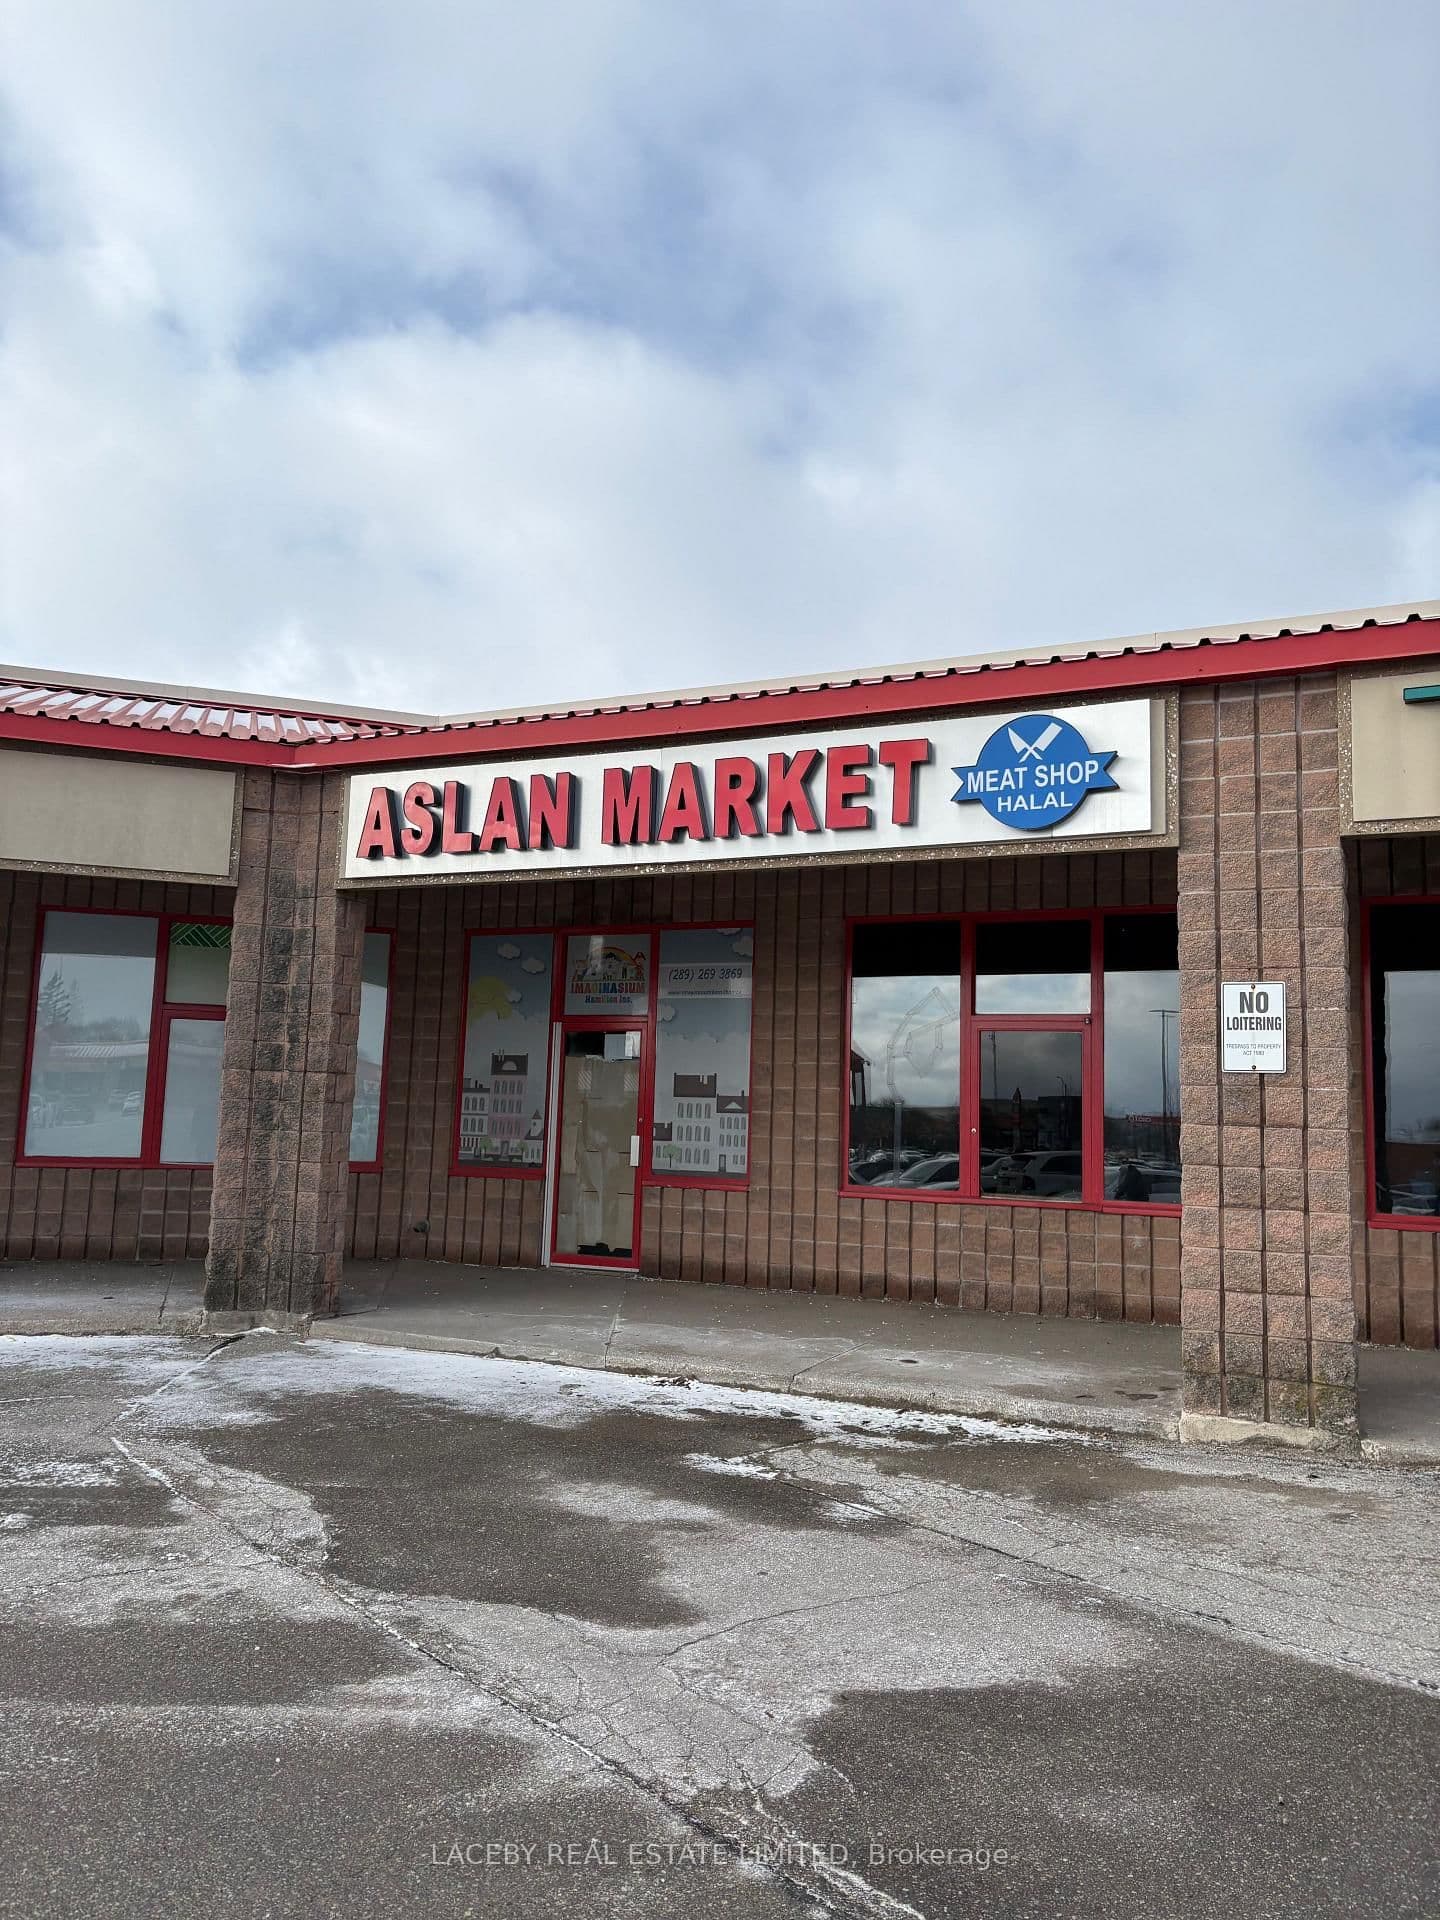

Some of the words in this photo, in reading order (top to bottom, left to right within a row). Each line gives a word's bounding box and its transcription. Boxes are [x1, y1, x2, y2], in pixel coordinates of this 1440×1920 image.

[967, 766, 1028, 794] MEAT
[1034, 760, 1099, 788] SHOP
[355, 771, 577, 859] ASLAN
[601, 737, 932, 845] MARKET
[997, 791, 1073, 813] HALAL
[668, 967, 695, 983] (289)
[697, 968, 716, 980] 269
[719, 967, 743, 980] 3869
[1239, 991, 1269, 1014] NO
[1226, 1016, 1282, 1031] LOITERING
